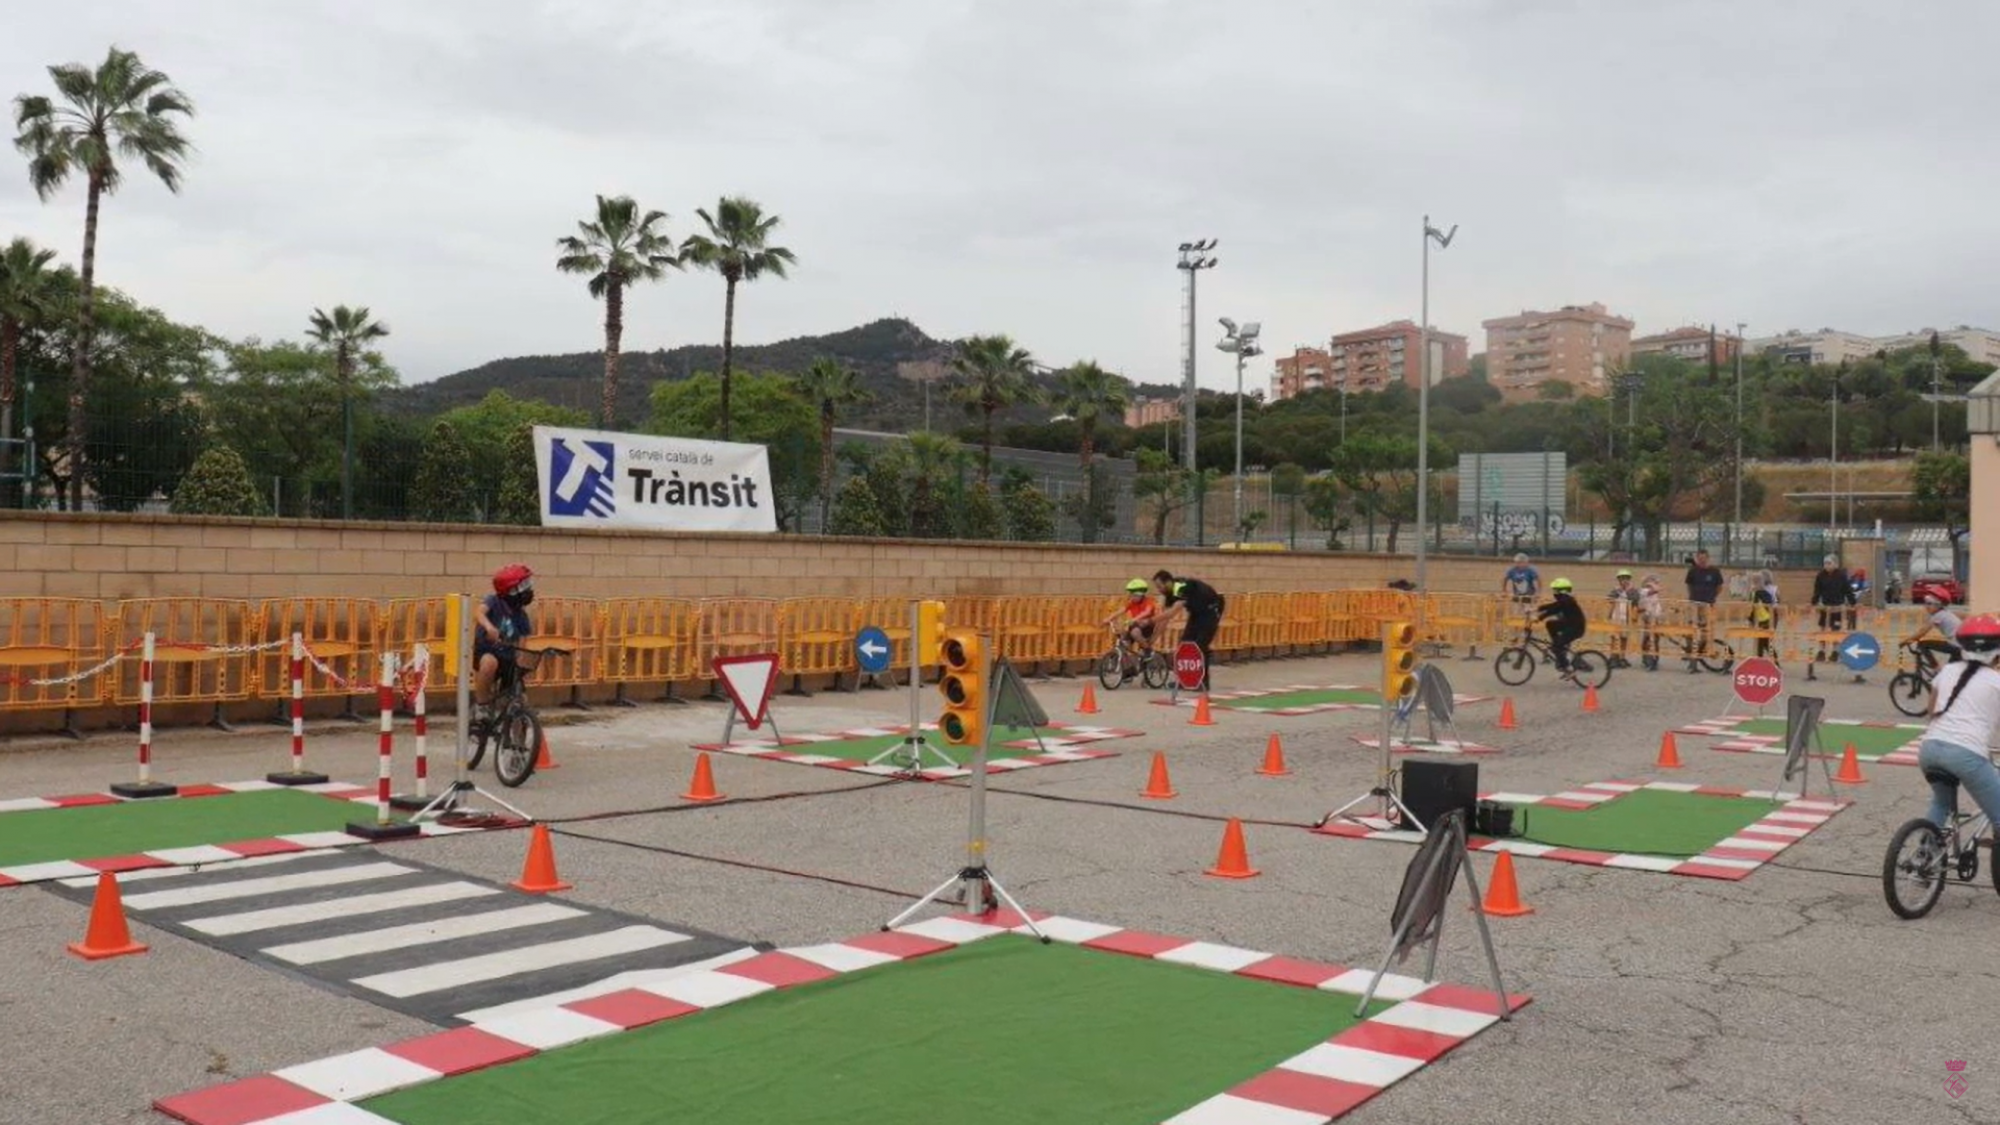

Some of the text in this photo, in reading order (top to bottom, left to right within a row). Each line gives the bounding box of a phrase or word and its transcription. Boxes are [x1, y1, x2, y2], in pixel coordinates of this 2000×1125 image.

[628, 448, 663, 461] servei
[700, 452, 714, 465] de
[628, 468, 758, 508] Trànsit
[1177, 659, 1201, 671] STOP
[1736, 674, 1778, 687] STOP
